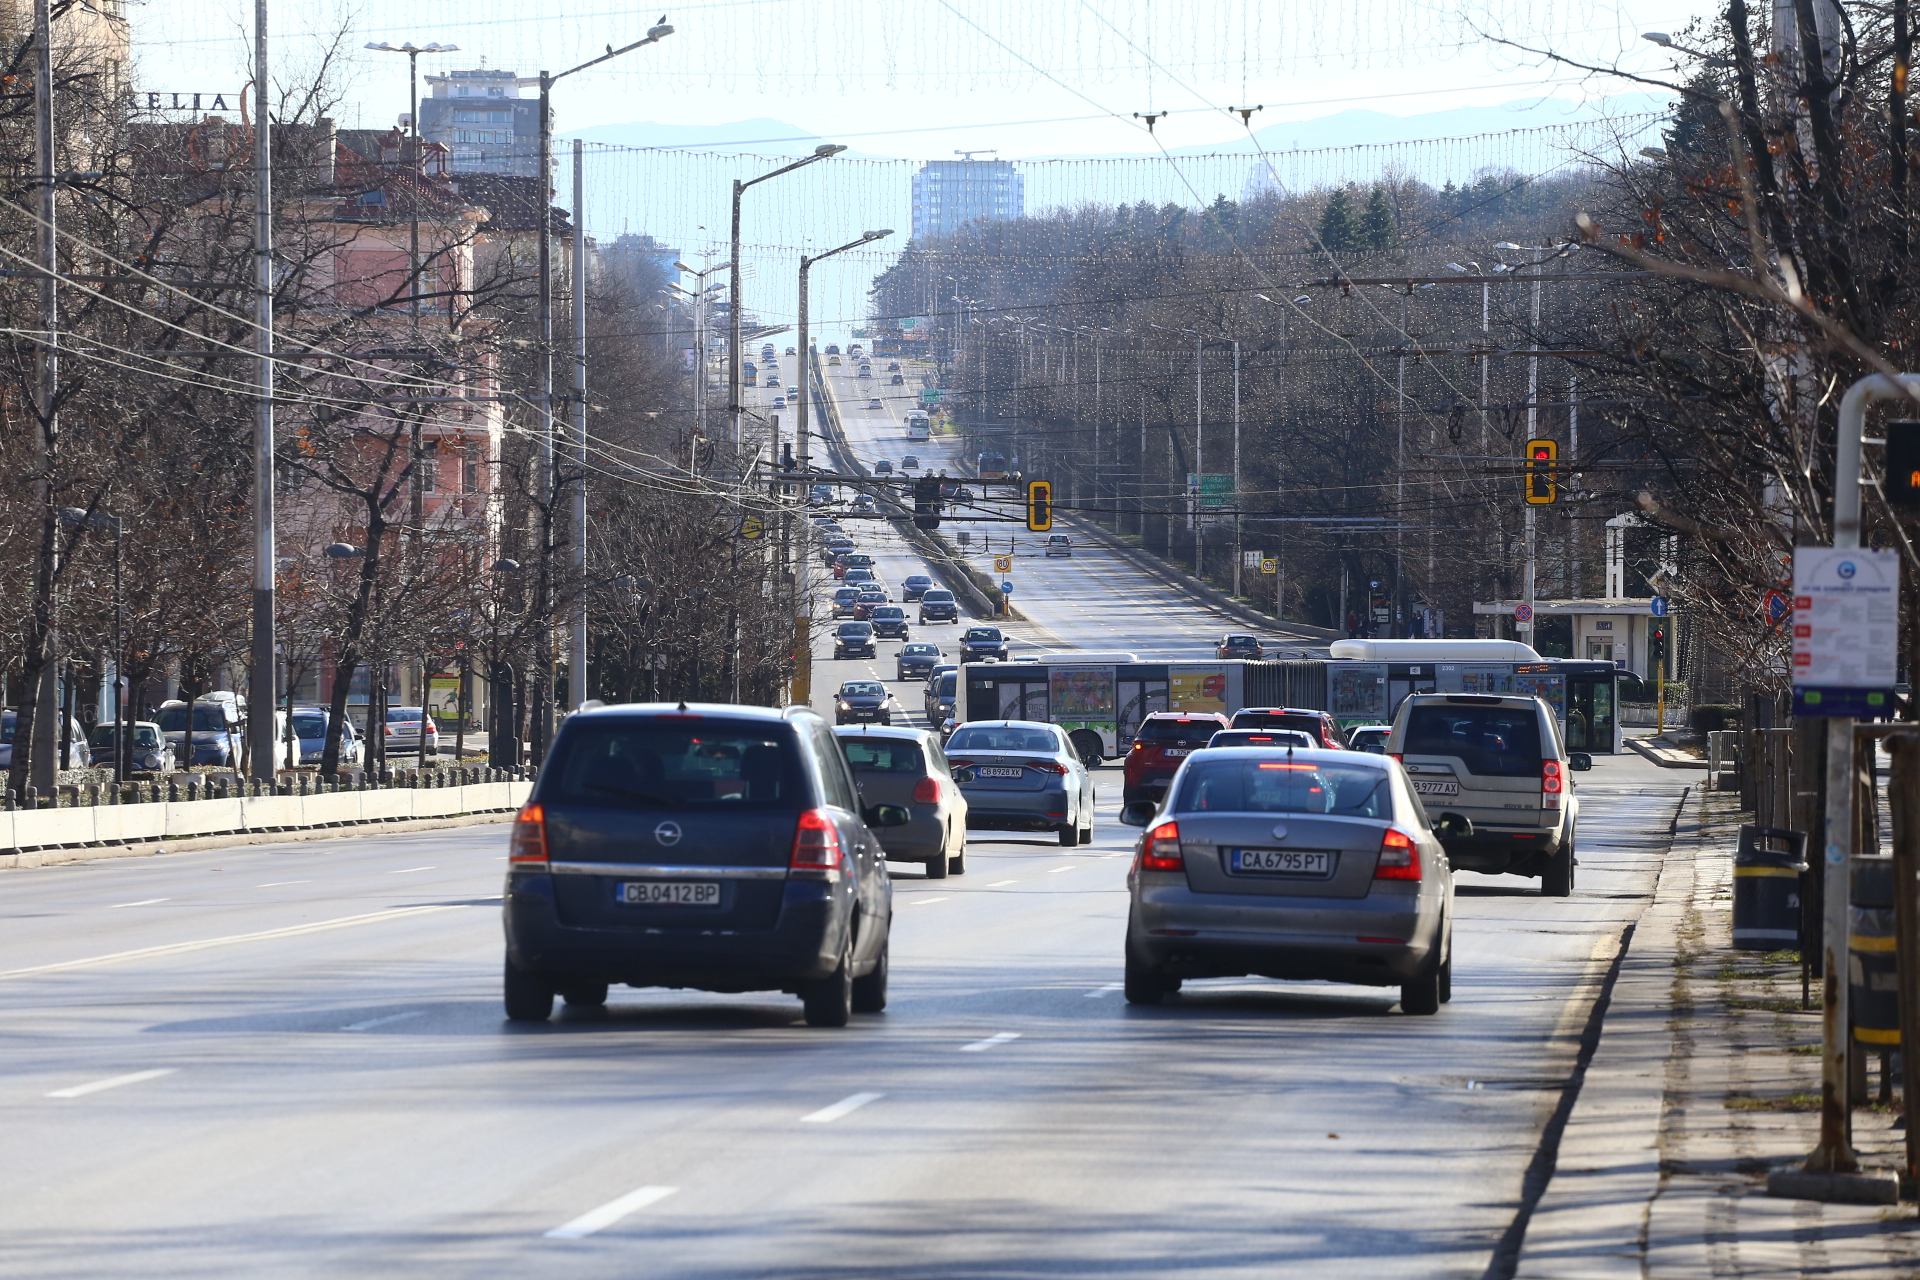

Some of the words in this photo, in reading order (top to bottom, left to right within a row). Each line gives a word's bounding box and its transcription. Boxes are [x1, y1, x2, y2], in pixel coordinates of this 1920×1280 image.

[999, 559, 1007, 567] 80
[1421, 782, 1444, 792] 9777
[1444, 783, 1457, 793] AX
[1265, 853, 1301, 868] 6795
[1304, 855, 1325, 870] PT
[651, 885, 692, 902] 0412
[694, 885, 717, 902] BP
